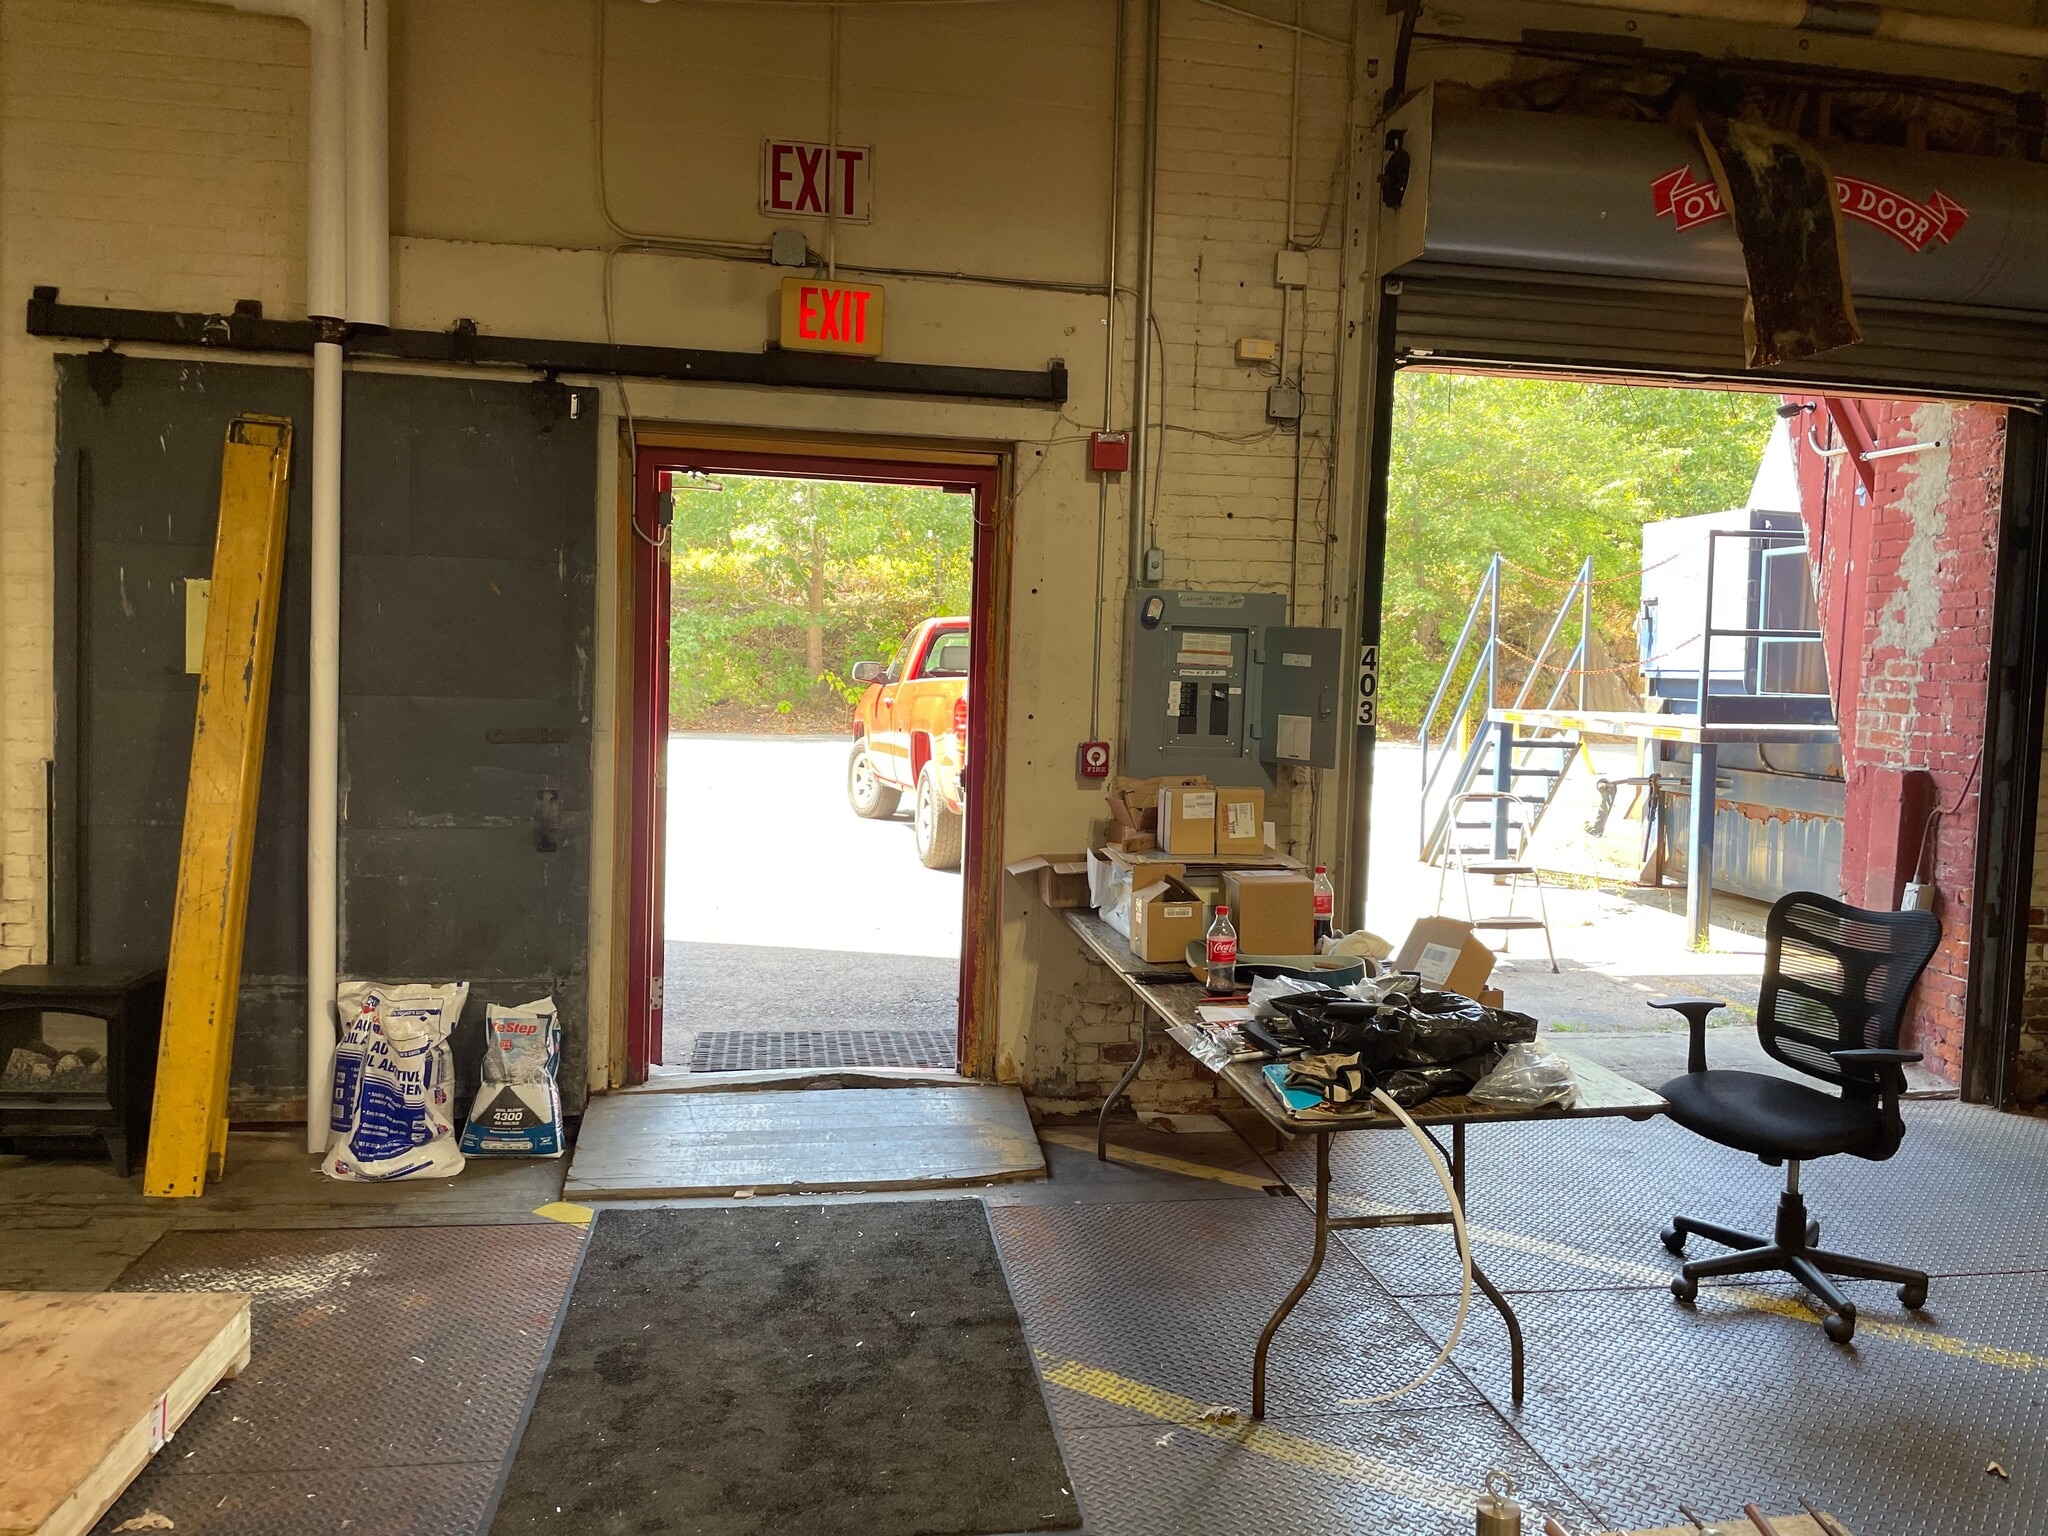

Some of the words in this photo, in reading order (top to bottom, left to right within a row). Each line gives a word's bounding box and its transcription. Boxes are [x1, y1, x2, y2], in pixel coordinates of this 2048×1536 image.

[1857, 188, 1930, 242] DOOR
[799, 286, 871, 343] EXIT
[1359, 647, 1377, 724] 403
[493, 1112, 523, 1121] 4300
